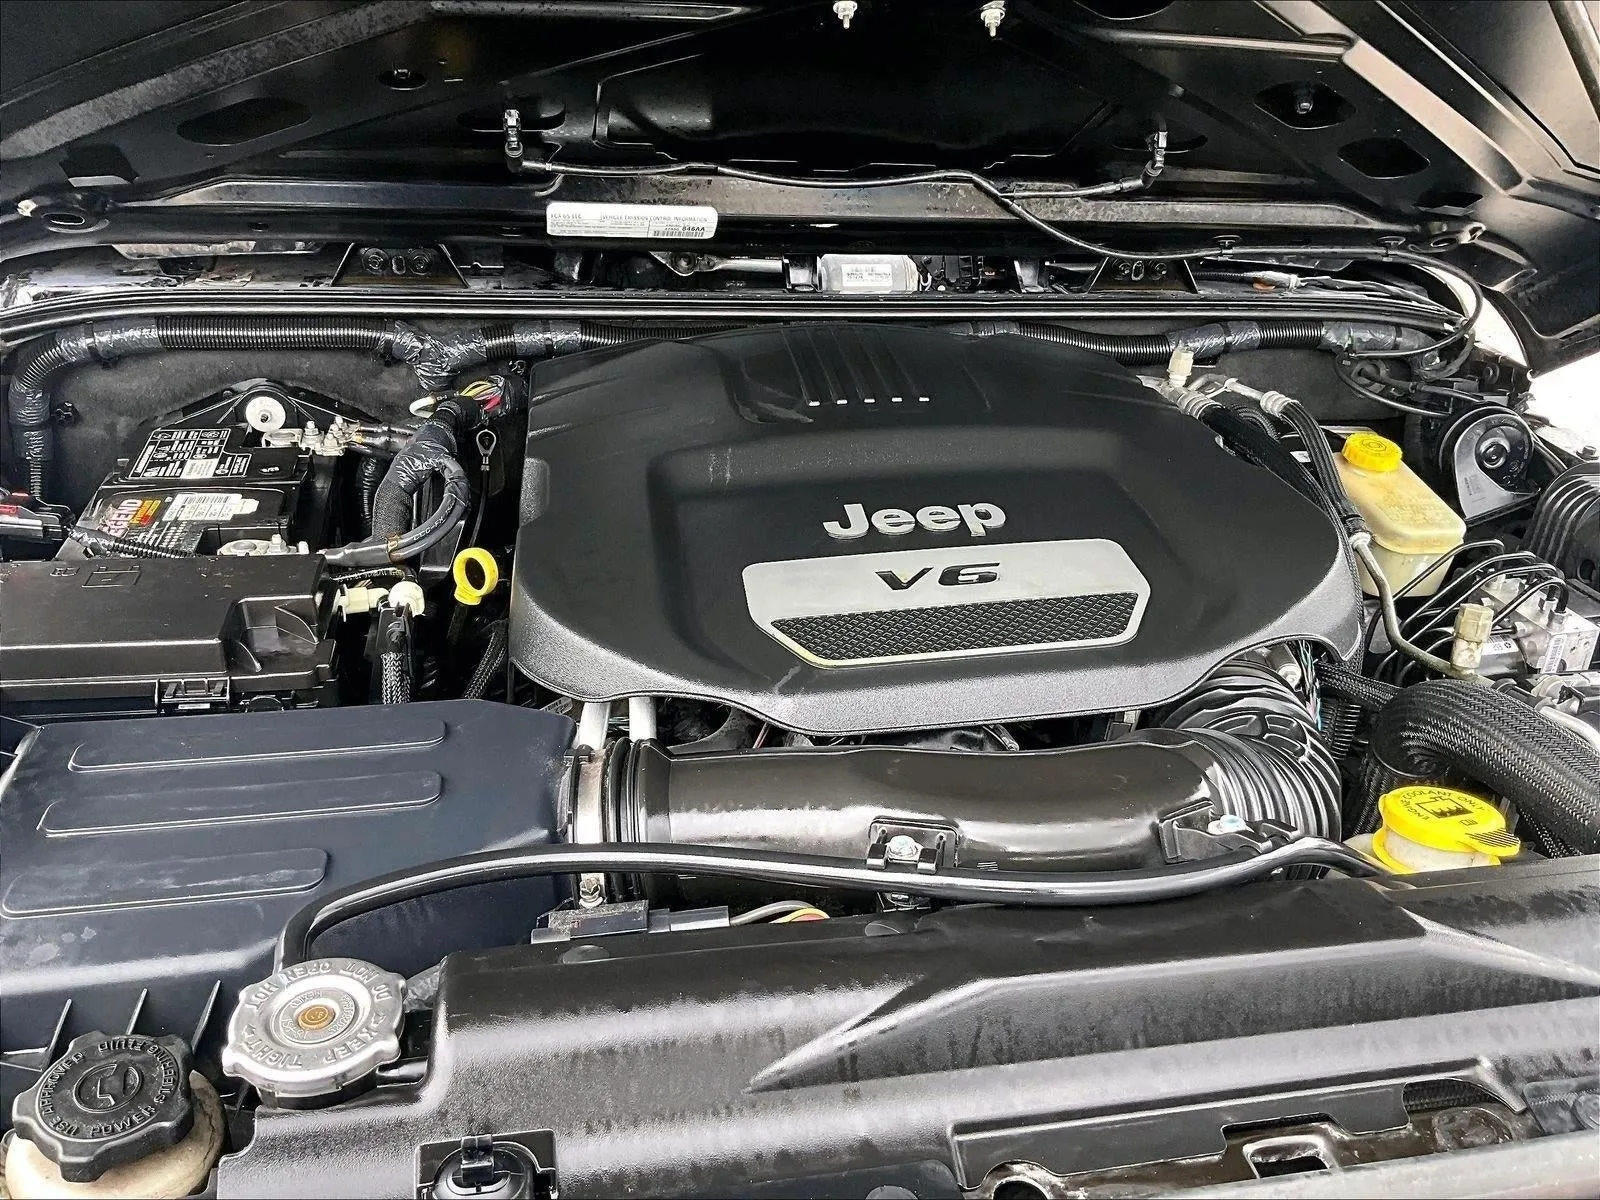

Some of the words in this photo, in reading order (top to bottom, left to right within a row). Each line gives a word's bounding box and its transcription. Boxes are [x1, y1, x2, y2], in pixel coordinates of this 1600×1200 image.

[823, 502, 1006, 539] Jeep
[875, 562, 1001, 591] V6
[1402, 790, 1452, 800] COOLANT
[1457, 796, 1485, 811] ONLY
[281, 962, 333, 983] OPEN
[338, 962, 379, 983] NOT
[245, 982, 279, 1010] HOT
[371, 983, 392, 1002] DO
[242, 1038, 302, 1068] TIGHT
[322, 1027, 378, 1064] KEEP
[39, 1052, 86, 1116] APPROVED
[91, 1105, 156, 1138] POWER
[147, 1043, 181, 1105] STEERING
[50, 1115, 80, 1138] USE
